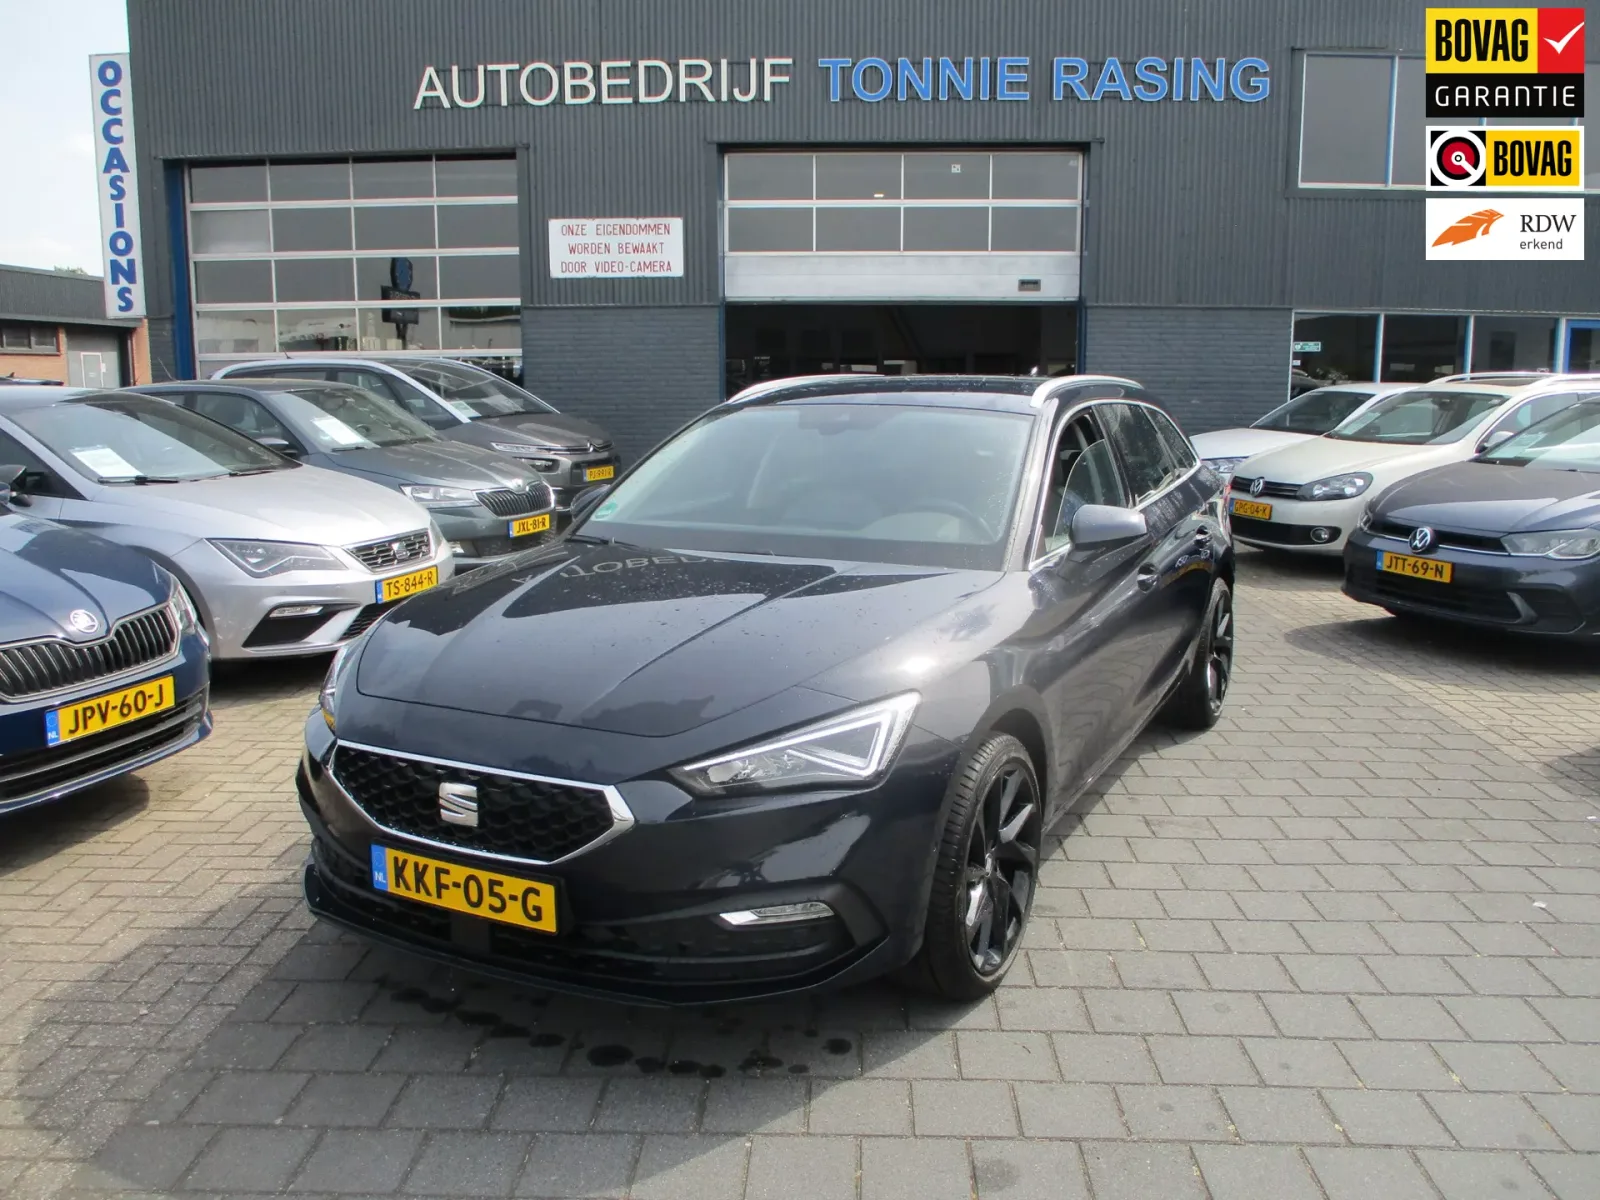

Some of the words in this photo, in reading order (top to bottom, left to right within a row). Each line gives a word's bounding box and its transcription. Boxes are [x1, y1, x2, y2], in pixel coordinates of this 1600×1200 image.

[413, 58, 793, 109] AUTOBEDRIJF
[818, 57, 1030, 102] TONNIE
[1053, 57, 1270, 102] RASING
[98, 60, 137, 312] OCCASIONS
[561, 224, 587, 236] ONZE
[596, 223, 671, 236] EIGENDOMMEN
[568, 242, 611, 255] WORDEN
[618, 242, 664, 255] BEWAAKT
[561, 261, 587, 273] DOOR
[594, 261, 672, 273] VIDEO-CAMERA
[517, 516, 547, 533] JXL-81-R
[1386, 555, 1444, 579] JTT-69-N
[386, 571, 433, 597] TS-844-R
[68, 684, 164, 734] JPV-60-J
[374, 871, 386, 883] NL
[393, 856, 543, 922] KKF-05-G
